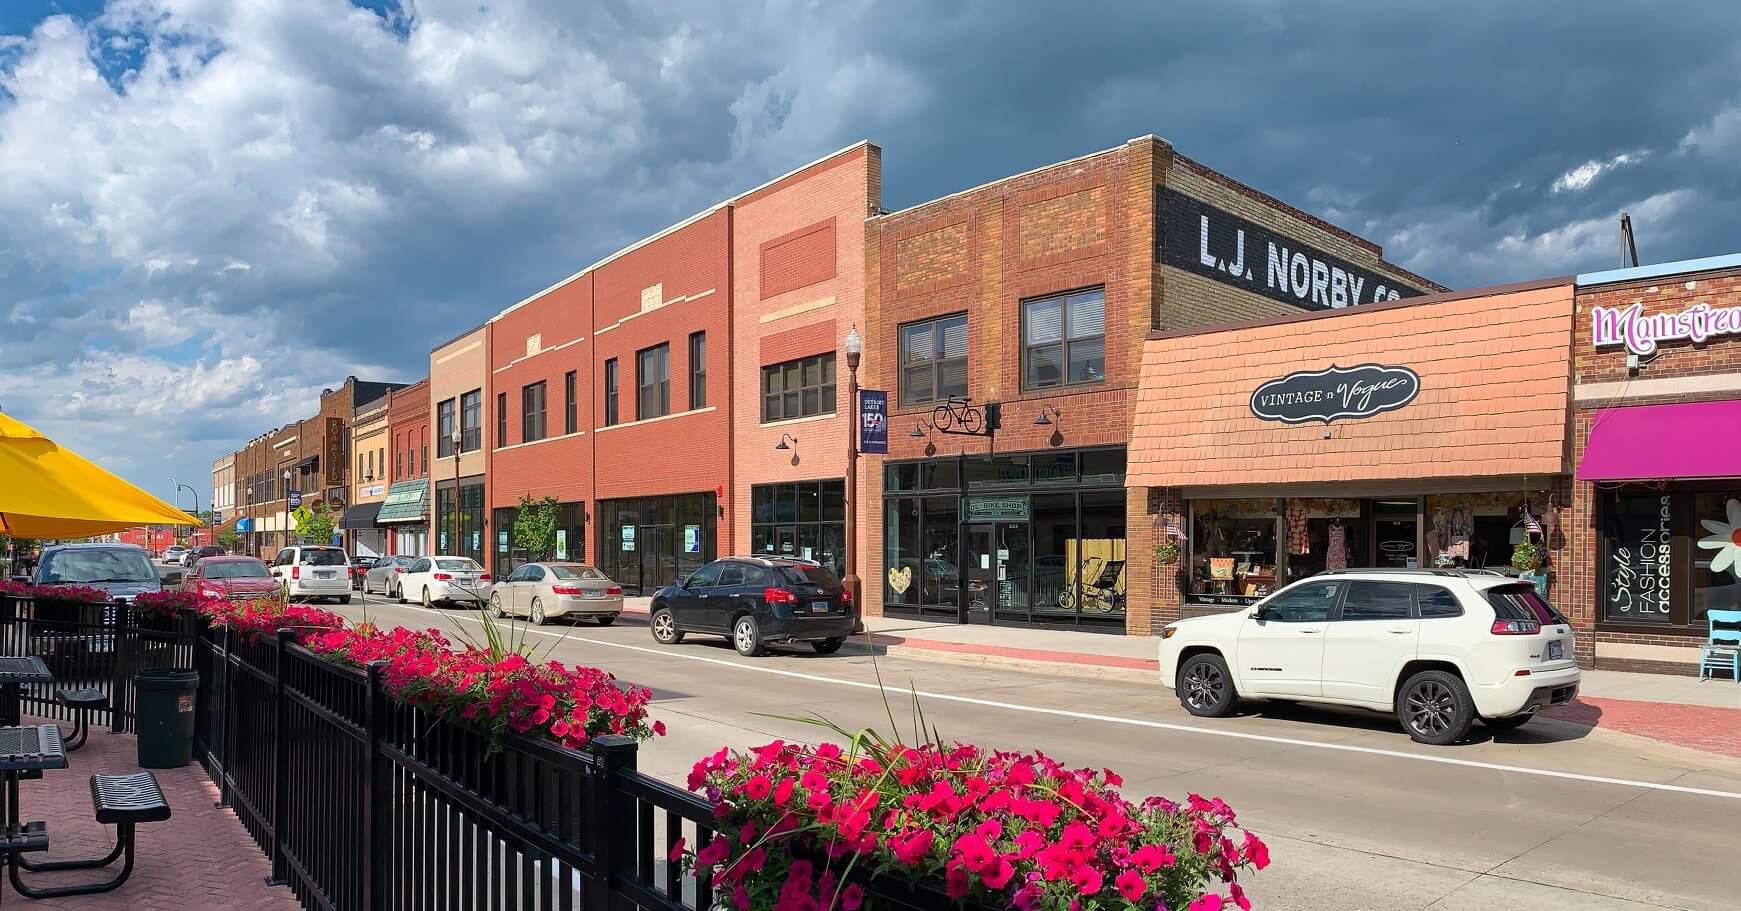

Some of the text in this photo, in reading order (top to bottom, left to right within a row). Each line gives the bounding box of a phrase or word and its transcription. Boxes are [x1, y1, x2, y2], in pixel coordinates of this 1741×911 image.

[1200, 214, 1254, 281] L.J.
[1267, 241, 1365, 309] NORBY
[1260, 390, 1323, 407] VINTAGE
[1336, 377, 1408, 411] Vogue
[1003, 501, 1024, 509] SHOP
[1611, 546, 1637, 612] Style
[1639, 528, 1656, 614] FASHION
[1658, 495, 1671, 614] accessories
